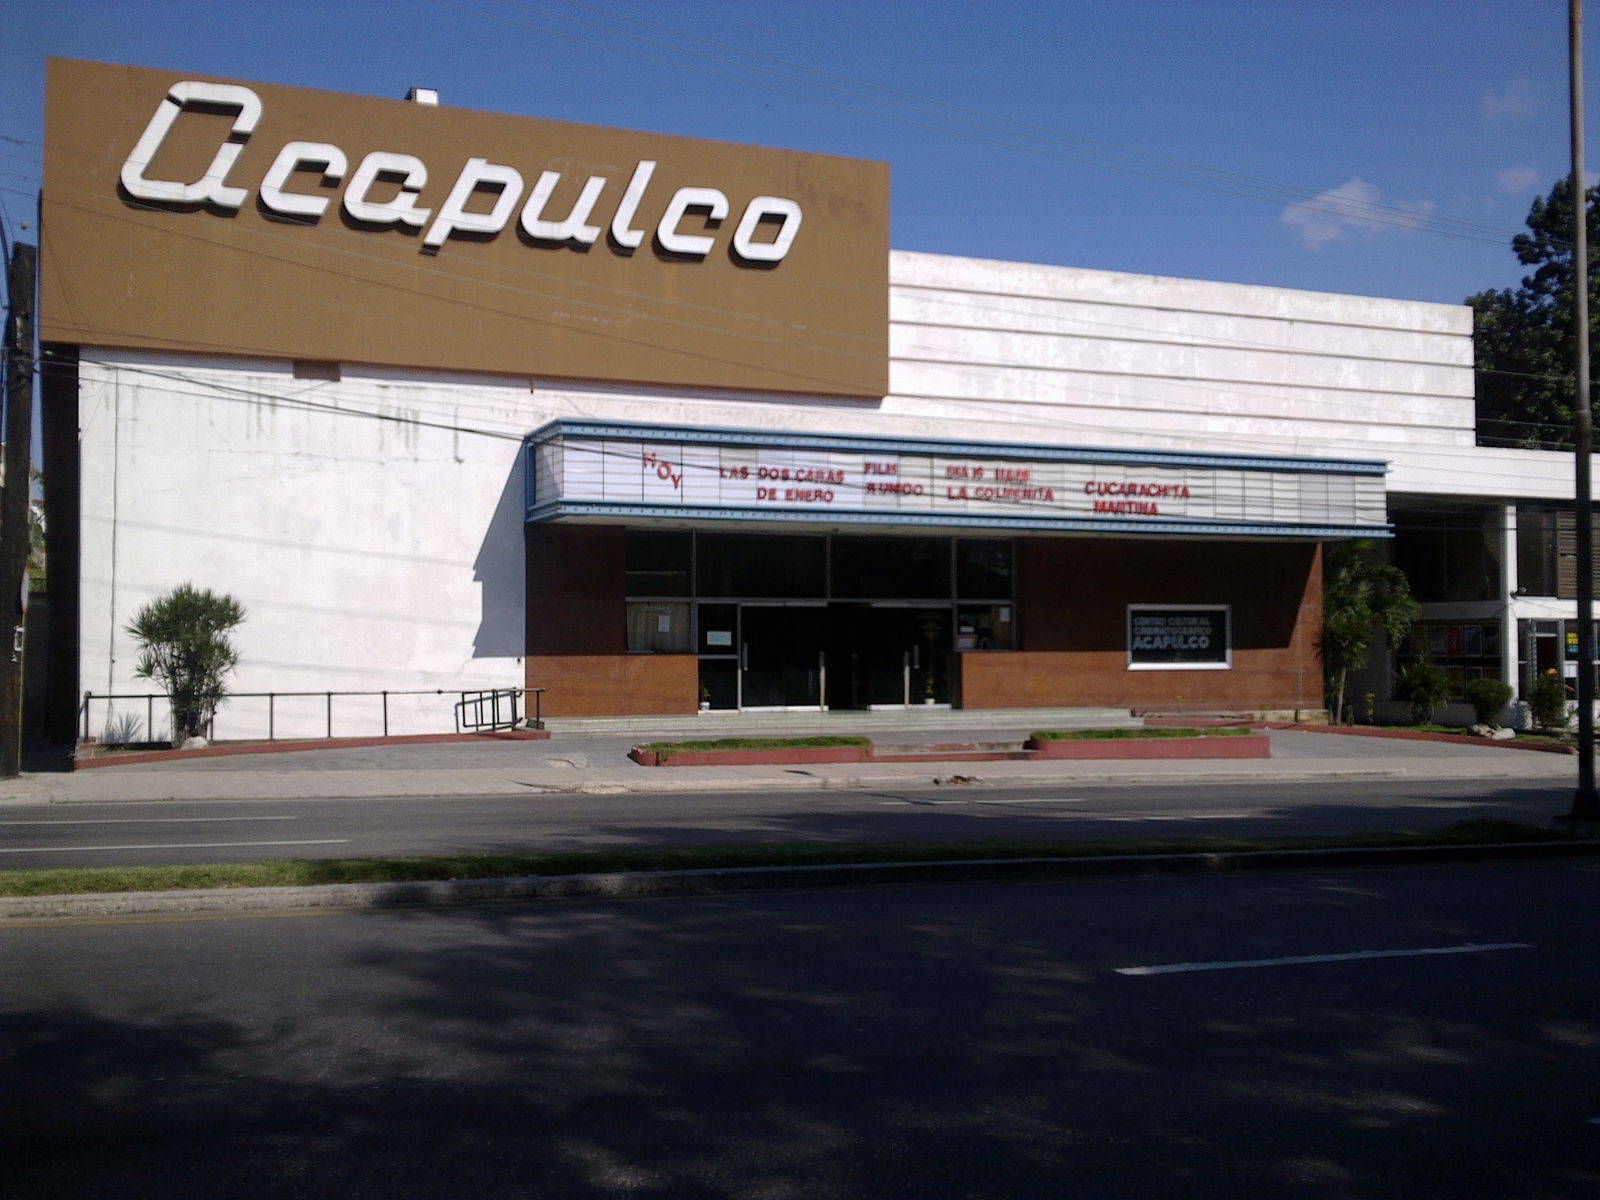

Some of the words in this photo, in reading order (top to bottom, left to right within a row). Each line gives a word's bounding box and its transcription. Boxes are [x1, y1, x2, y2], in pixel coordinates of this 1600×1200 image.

[120, 81, 802, 262] Acapulco
[643, 452, 683, 489] HOY
[719, 466, 749, 480] LAS
[758, 467, 790, 481] DOS
[795, 468, 844, 484] CARAS
[864, 463, 897, 475] FILM
[757, 488, 778, 501] DE
[785, 489, 834, 503] ENERO
[947, 486, 969, 499] LA
[975, 486, 1055, 502] COLMENITA
[1085, 481, 1190, 498] CUCARACHITA
[1094, 501, 1159, 516] MARTINA
[1133, 636, 1209, 649] ACAPULCO
